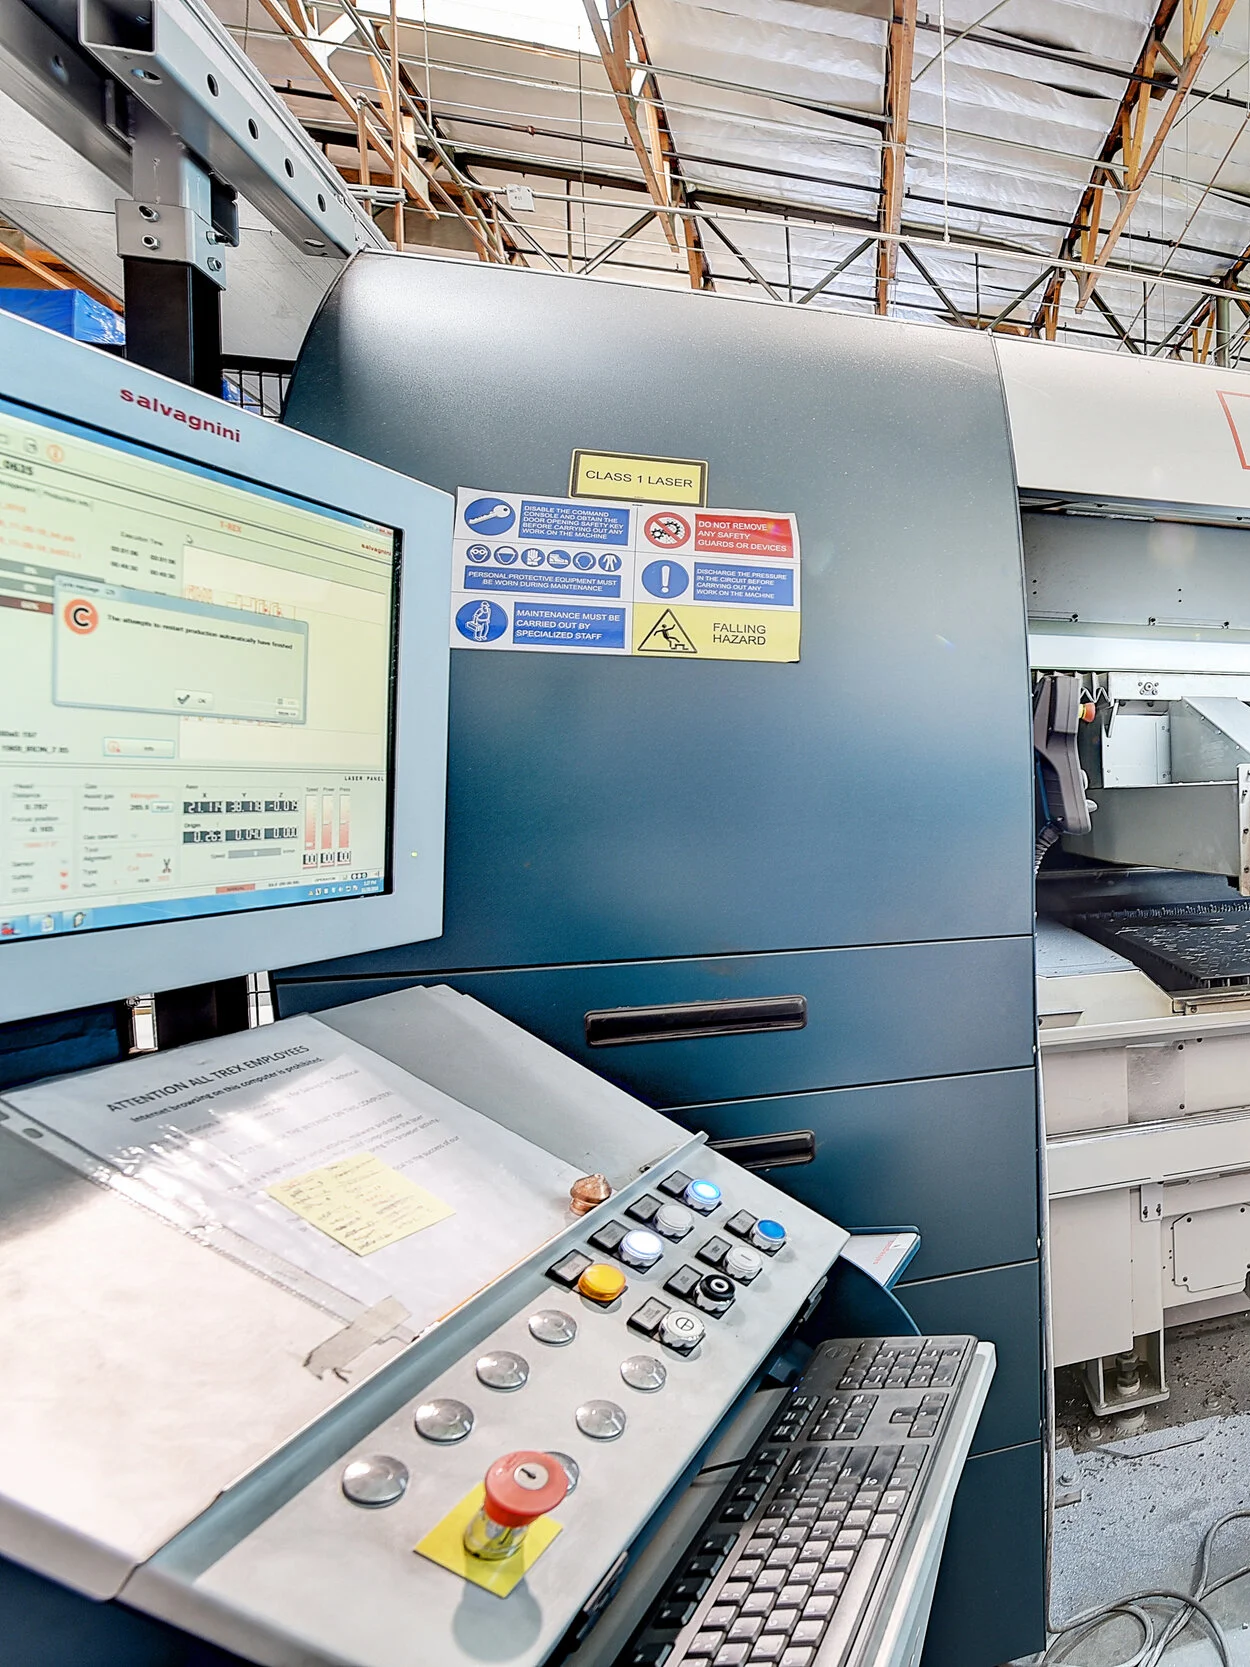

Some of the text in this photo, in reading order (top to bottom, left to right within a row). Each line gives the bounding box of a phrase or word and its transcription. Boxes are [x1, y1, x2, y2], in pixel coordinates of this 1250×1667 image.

[120, 388, 241, 443] salvagnini
[585, 470, 693, 488] CLASS 1 LASER
[524, 505, 555, 513] DISABLE
[572, 509, 609, 517] COMMAND
[524, 511, 559, 519] CONSOLE
[220, 521, 242, 533] T-REX
[546, 518, 580, 526] OPENING
[713, 521, 731, 529] NOT
[732, 522, 767, 531] REMOVE
[553, 525, 592, 533] CARRYING
[717, 531, 751, 540] SAFETY
[361, 543, 392, 556] salvagnini
[697, 539, 735, 548] GUARDS
[750, 543, 787, 552] DEVICES
[468, 571, 509, 580] PERSONAL
[509, 573, 554, 582] PROTECTIVE
[555, 576, 597, 585] EQUIPMENT
[697, 568, 737, 577] DISCHARGE
[752, 572, 788, 580] PRESSURE
[494, 579, 519, 587] WORN
[520, 581, 549, 589] DURING
[550, 583, 603, 591] MAINTENANCE
[720, 576, 747, 584] CIRCUIT
[697, 582, 732, 590] CARRYING
[745, 591, 775, 599] MACHINE
[516, 610, 581, 619] MAINTENANCE
[582, 613, 606, 621] MUST
[516, 620, 557, 628] CARRIED
[713, 622, 766, 634] FALLING
[107, 614, 120, 622] The
[123, 616, 151, 627] attempts
[162, 624, 184, 634] restart
[185, 626, 218, 638] production
[219, 633, 256, 644] automatically
[257, 637, 271, 646] have
[271, 640, 293, 650] finished
[515, 630, 603, 640] SPECIALIZED STAFF
[713, 634, 766, 645] HAZARD
[107, 1045, 311, 1112] ATTENTION ALL TREX EMPLOYEES
[130, 1104, 170, 1123] Internet
[169, 1092, 214, 1111] browsing
[223, 1083, 241, 1093] this
[240, 1071, 279, 1088] computer
[284, 1056, 325, 1074] prohibited.
[387, 1113, 403, 1122] other
